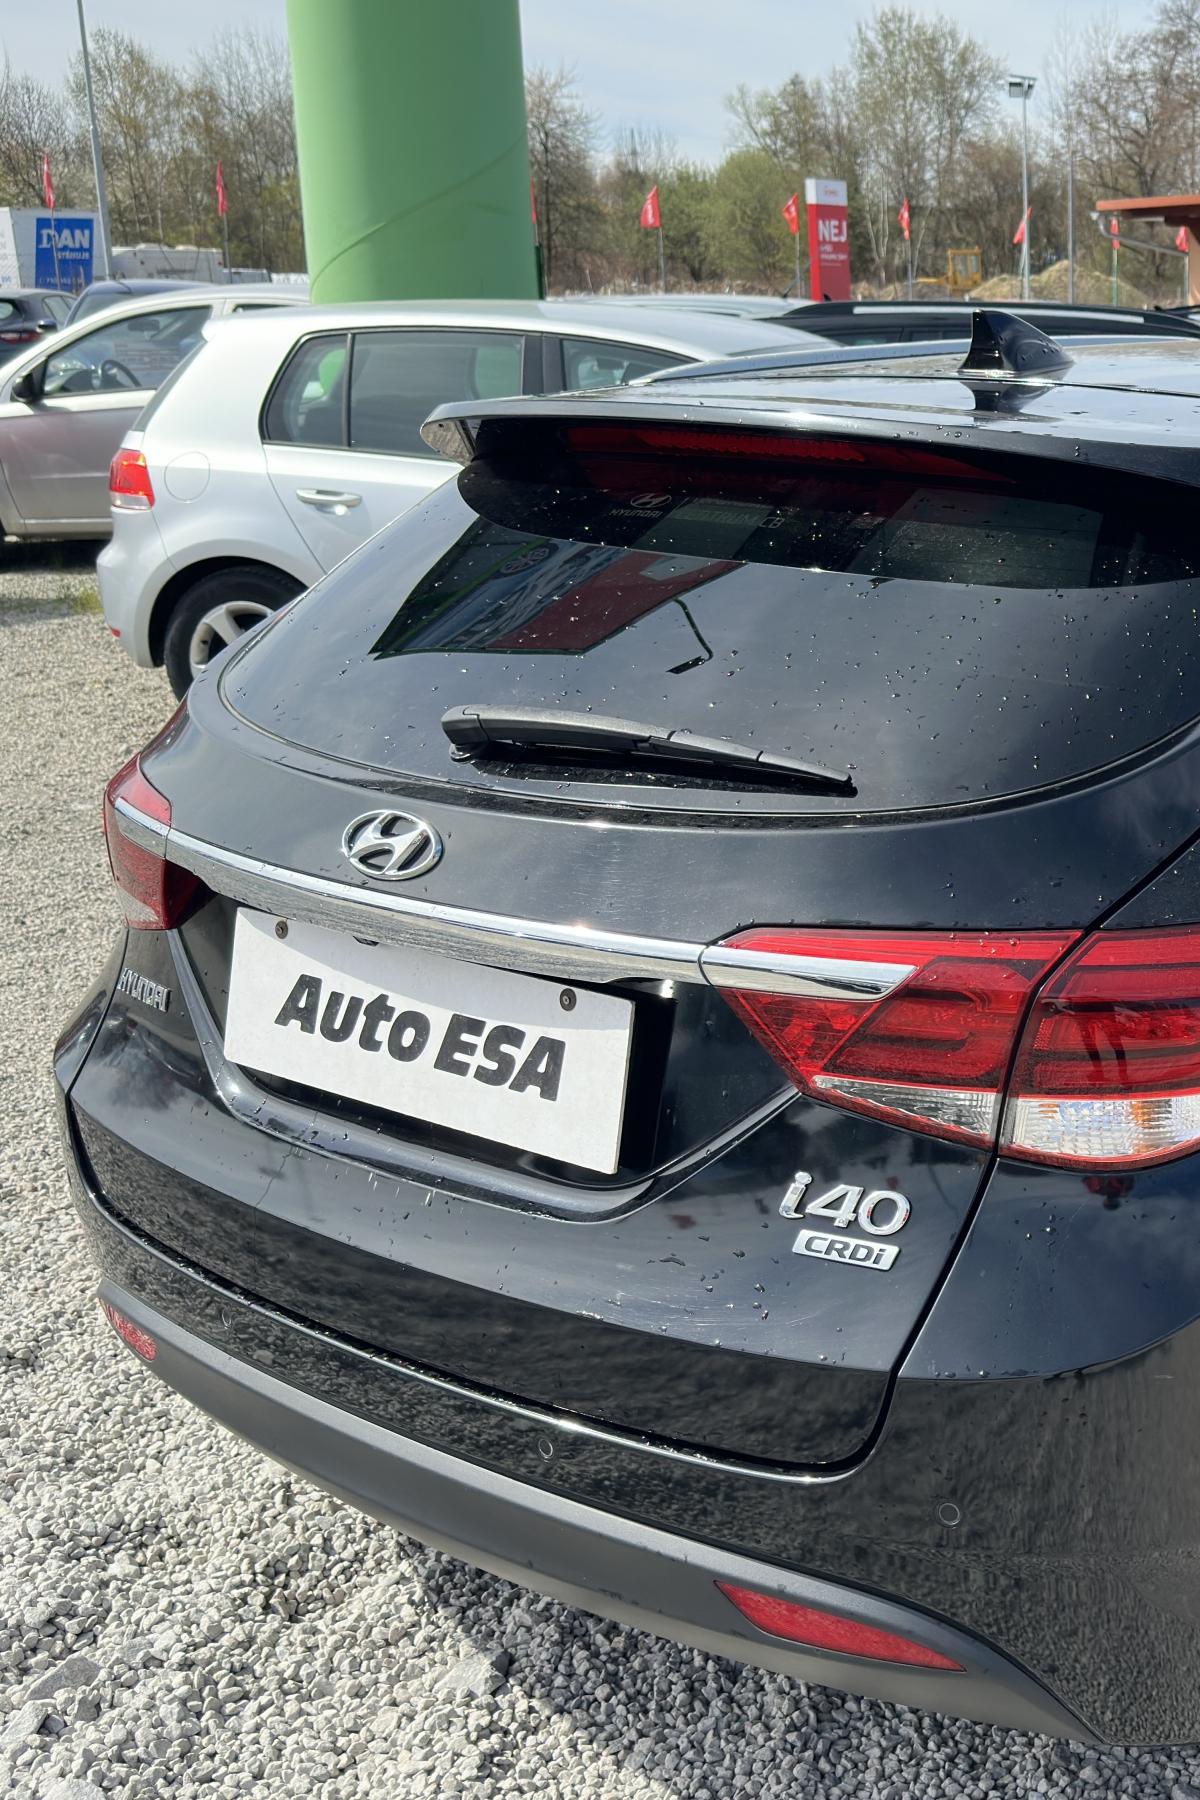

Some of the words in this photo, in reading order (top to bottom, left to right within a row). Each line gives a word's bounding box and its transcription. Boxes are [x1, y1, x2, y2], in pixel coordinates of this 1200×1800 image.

[38, 228, 90, 249] DAN
[818, 219, 847, 242] NEJ
[609, 508, 664, 518] HYUNDAI
[117, 967, 169, 1012] HYUNDAI
[275, 973, 431, 1062] Auto
[433, 1014, 566, 1101] ESA
[778, 1171, 911, 1236] i40
[804, 1236, 887, 1265] CRDi
